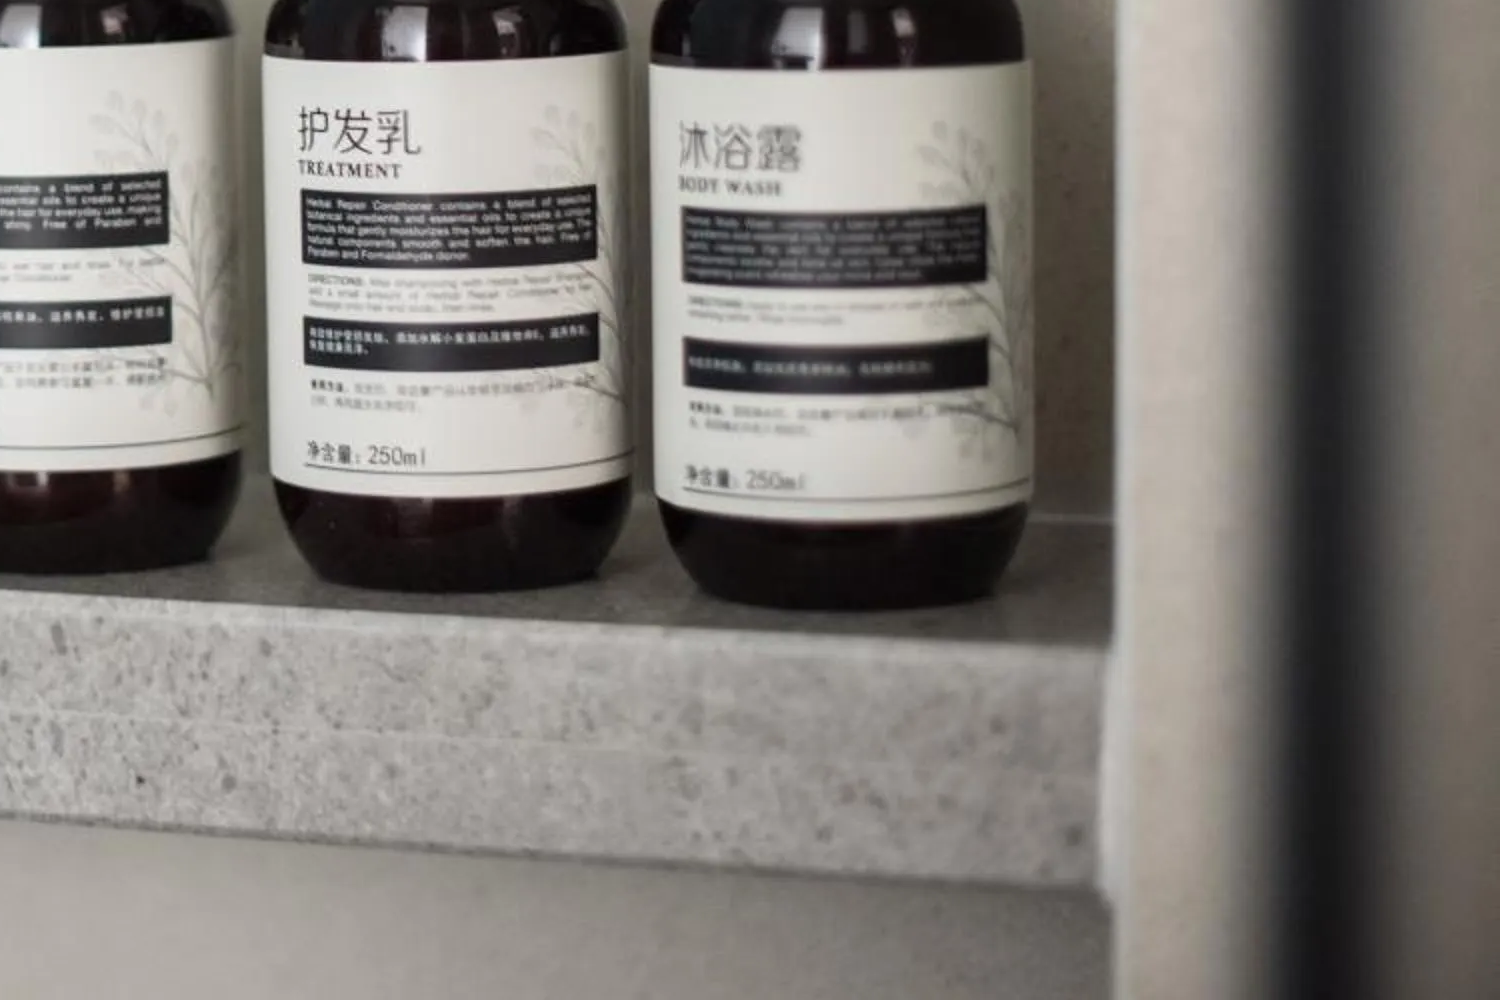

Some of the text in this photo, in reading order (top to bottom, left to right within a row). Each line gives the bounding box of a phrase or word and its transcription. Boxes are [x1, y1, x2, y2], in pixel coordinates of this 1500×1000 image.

[297, 105, 422, 155] 护发乳
[678, 119, 802, 173] 沐浴露
[297, 159, 403, 180] TREATMENT
[677, 174, 784, 198] BODY WASH
[372, 200, 434, 212] Conditioner
[439, 201, 487, 211] contains
[401, 238, 444, 249] smooth
[367, 443, 426, 468] 250ml
[745, 467, 806, 492] 250ml
